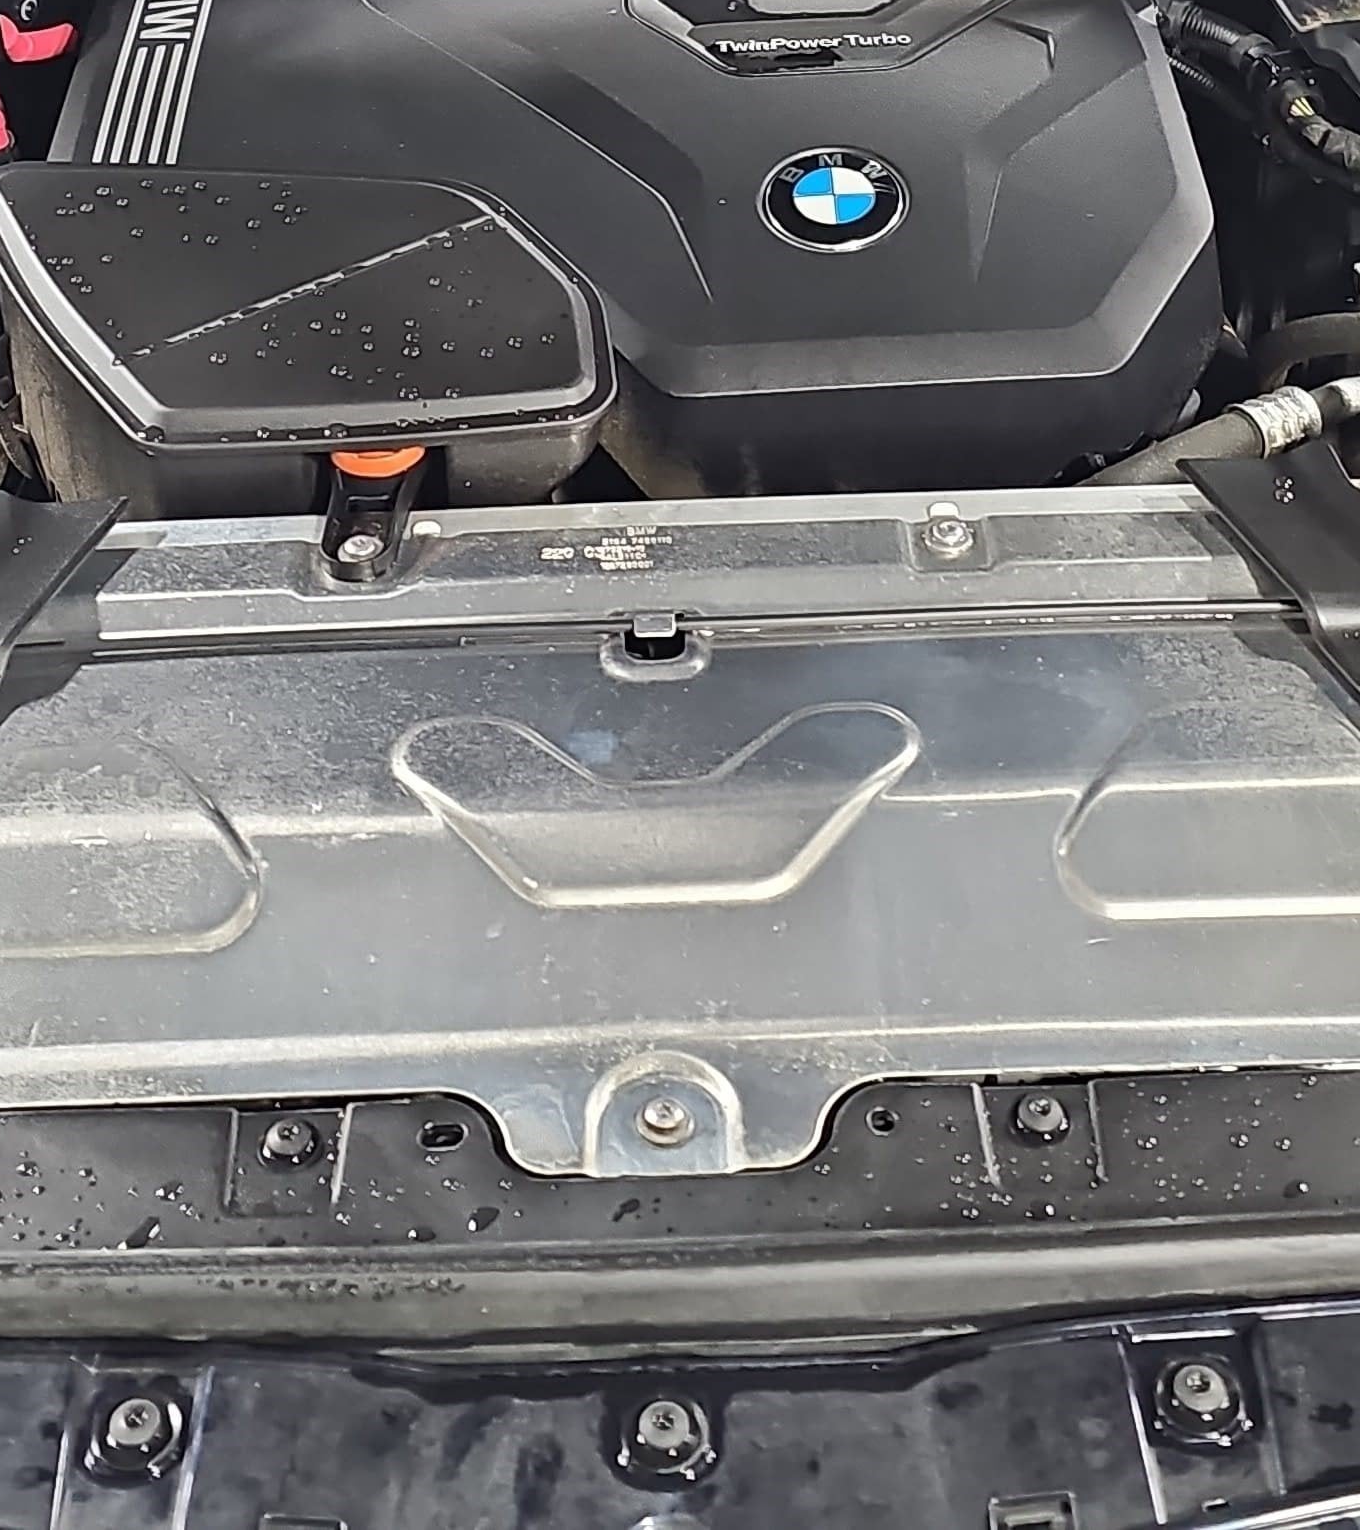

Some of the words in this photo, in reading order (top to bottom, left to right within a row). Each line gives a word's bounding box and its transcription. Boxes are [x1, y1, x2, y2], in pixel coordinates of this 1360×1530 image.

[715, 37, 842, 53] TwinPower
[843, 32, 912, 46] Turbo
[778, 153, 889, 183] BMW
